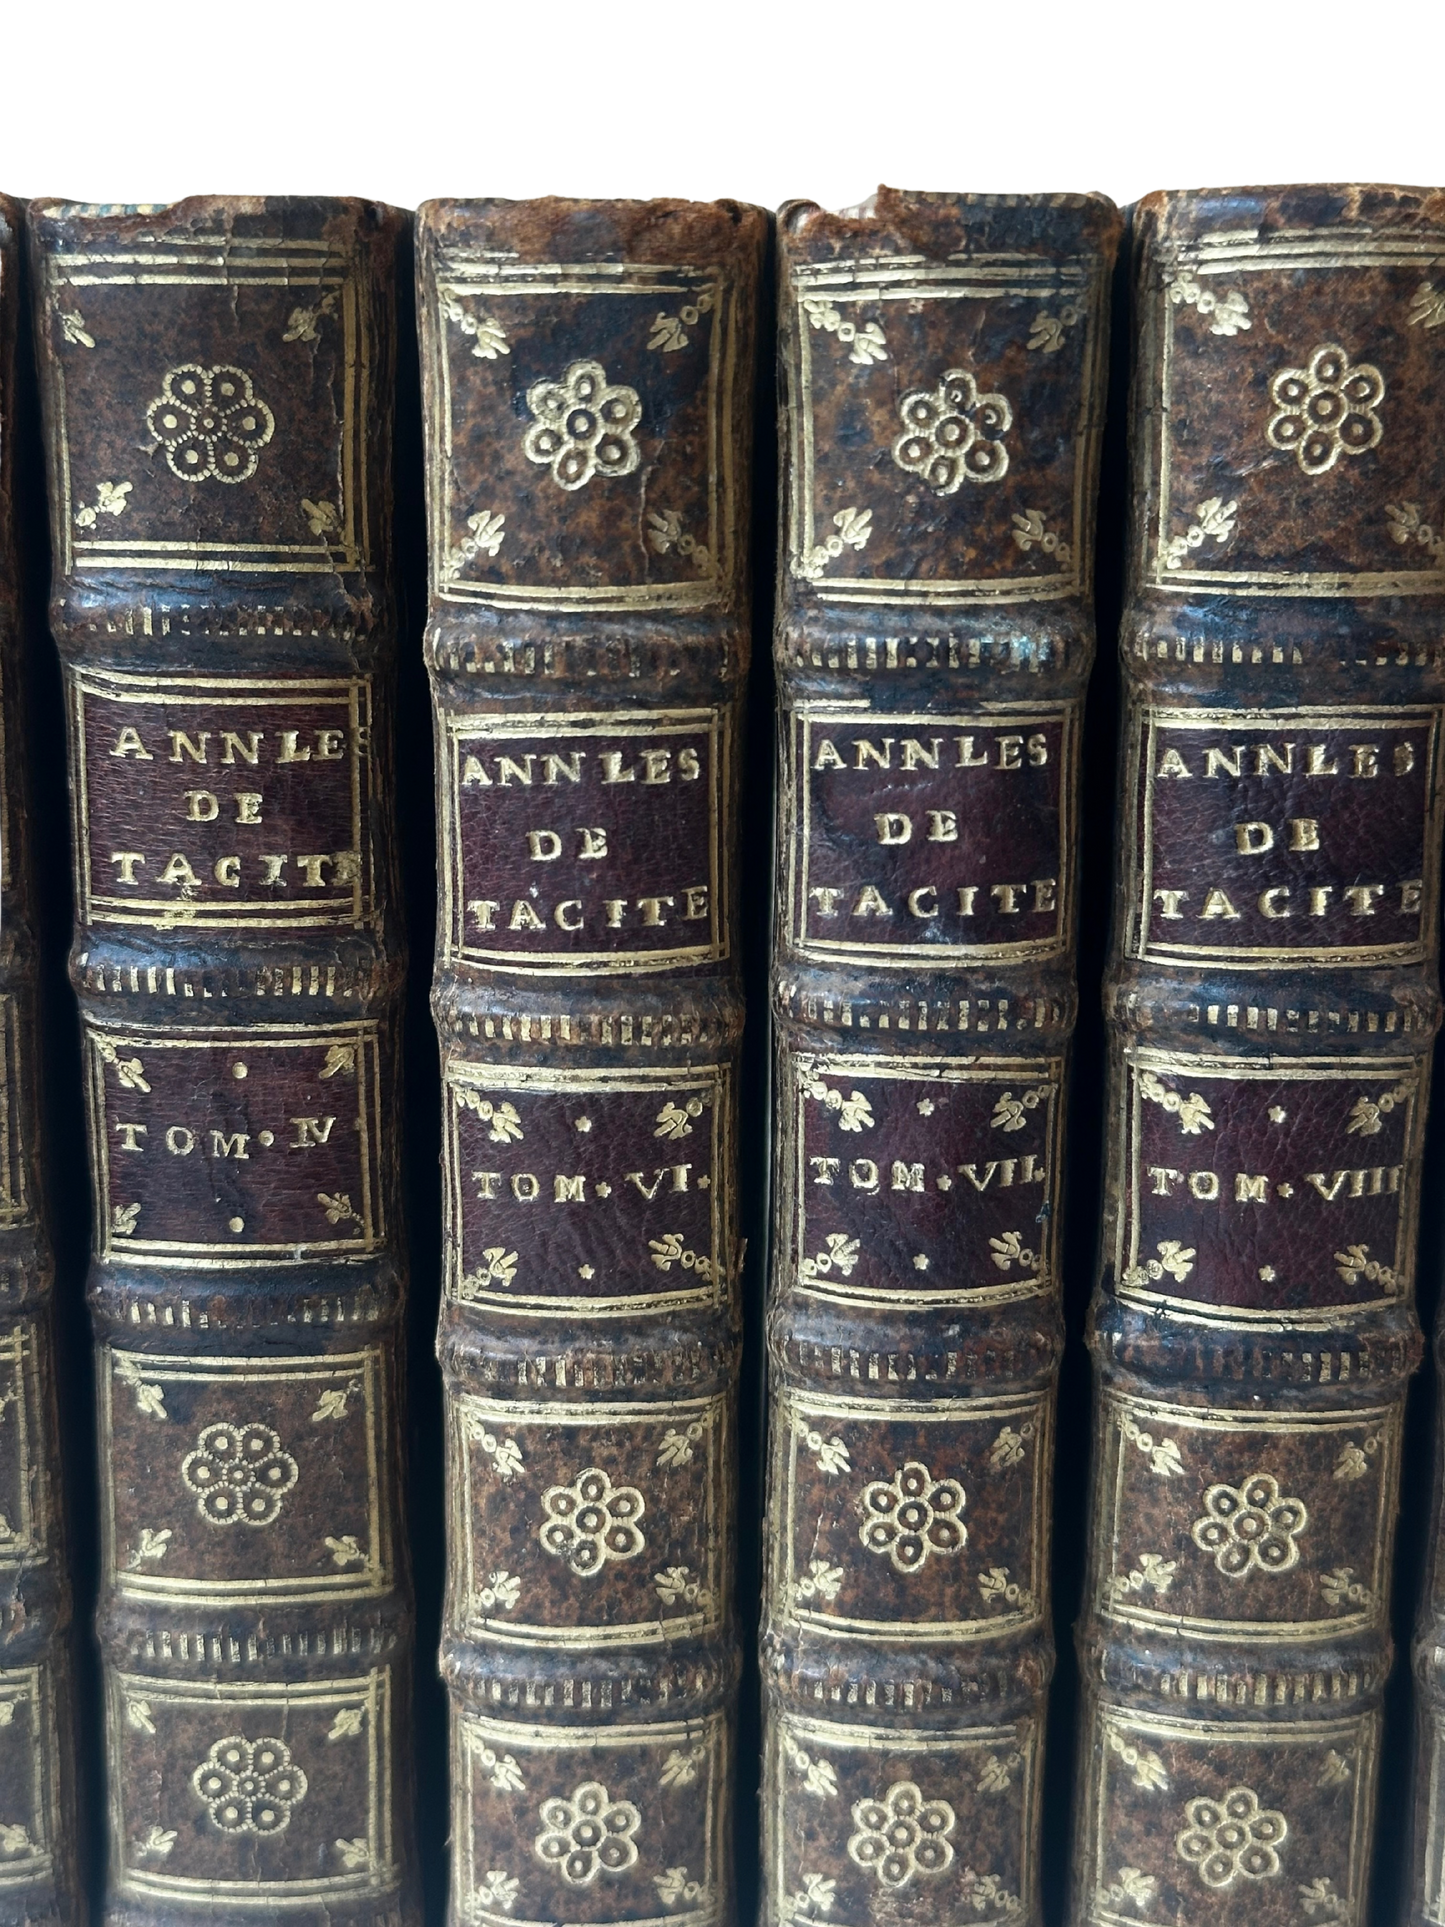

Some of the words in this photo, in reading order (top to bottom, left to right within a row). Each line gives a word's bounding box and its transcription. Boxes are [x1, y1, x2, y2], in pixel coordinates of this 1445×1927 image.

[461, 748, 701, 787] ANNLES
[810, 733, 1048, 771] ANNLES
[184, 790, 264, 824] DE
[525, 827, 608, 861] DE
[873, 810, 959, 845] DE
[1234, 818, 1320, 855] DE
[467, 885, 708, 931] TACITE
[809, 878, 1056, 918] TACITE
[1153, 879, 1423, 919] TACITE
